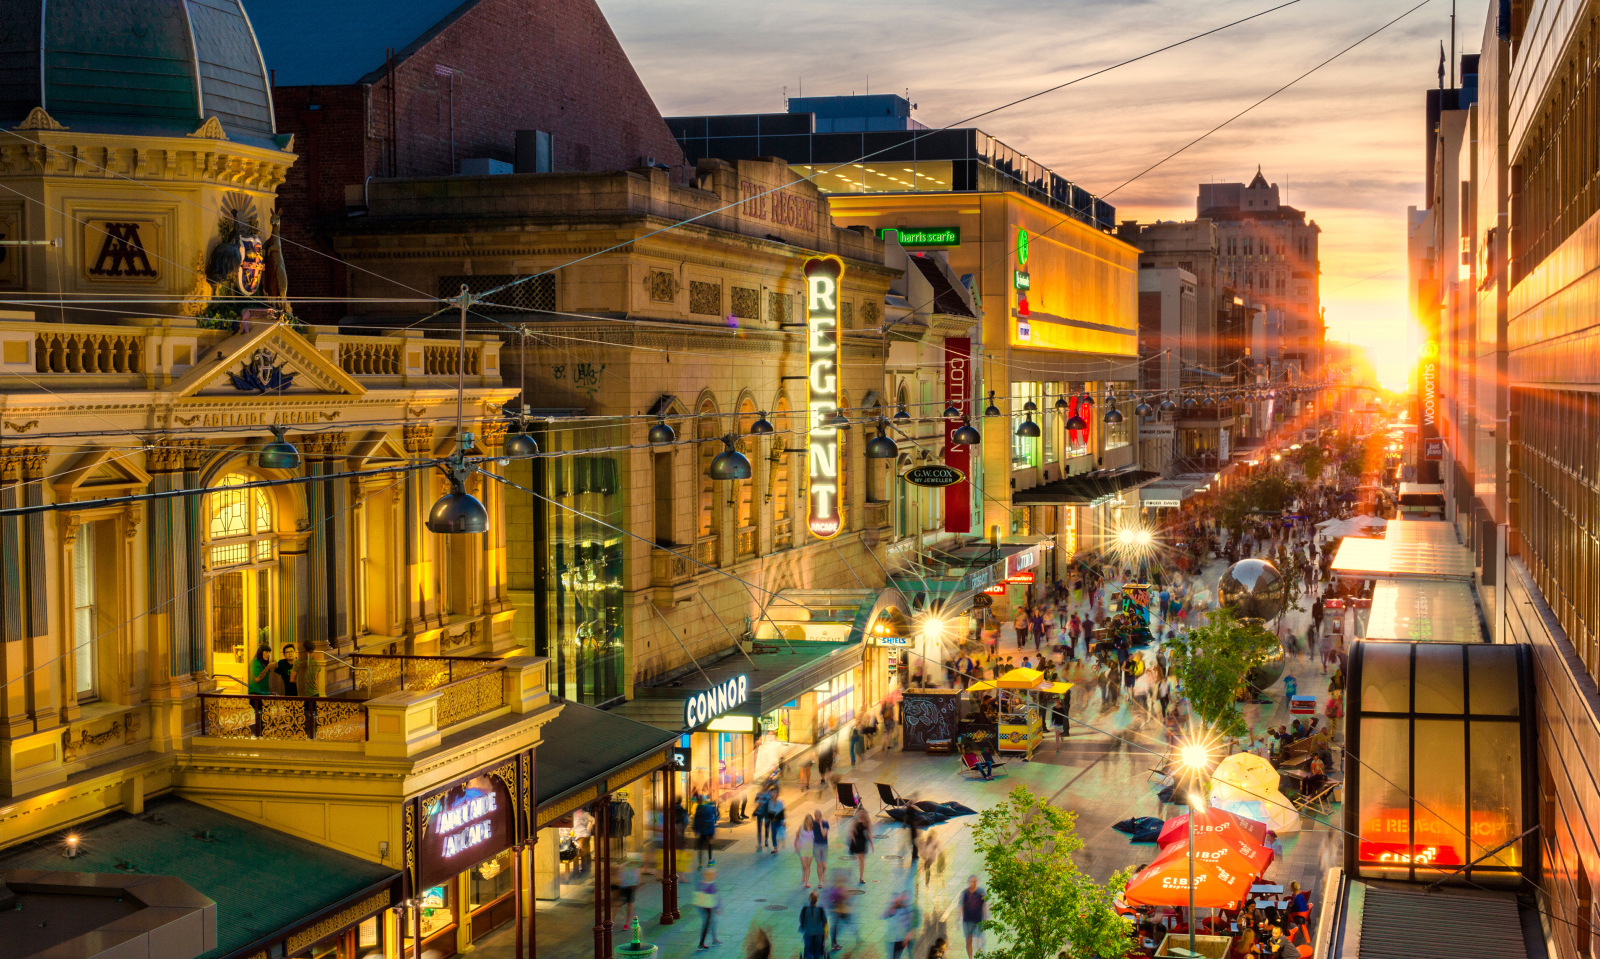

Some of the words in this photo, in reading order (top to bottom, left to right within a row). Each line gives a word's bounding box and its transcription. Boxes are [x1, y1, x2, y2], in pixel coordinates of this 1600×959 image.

[741, 181, 767, 220] THE
[771, 190, 817, 232] REGENT
[900, 231, 926, 242] harris
[927, 230, 955, 242] scarfe
[808, 276, 837, 518] REGENT
[1423, 364, 1435, 425] woolworths
[203, 412, 267, 427] ADELAIDE
[273, 411, 319, 425] ARCADE
[1426, 448, 1442, 457] Jeans
[913, 469, 932, 478] G.W.
[932, 469, 953, 478] COX
[810, 523, 838, 533] ARCADE
[685, 674, 748, 728] CONNOR
